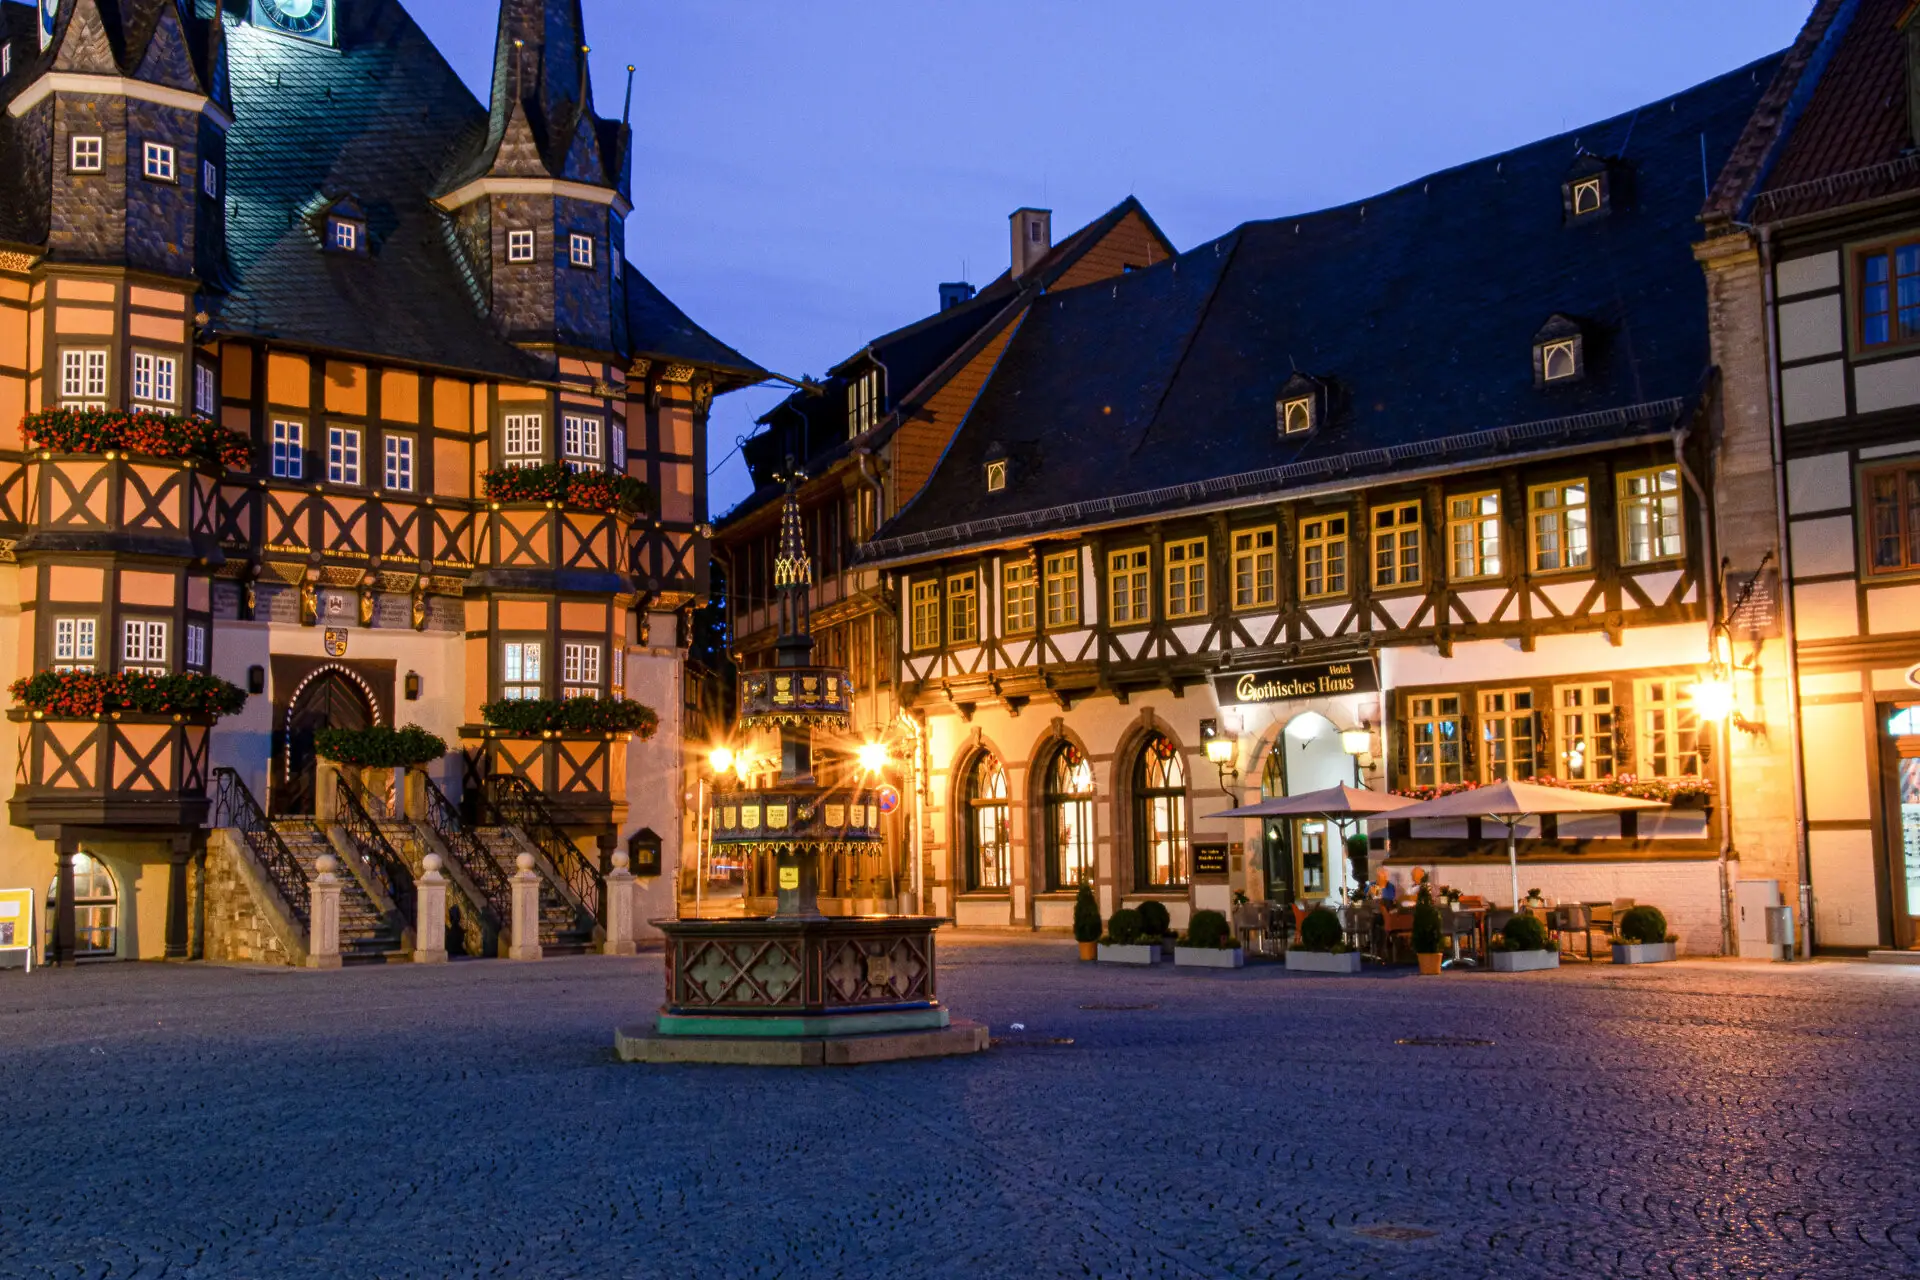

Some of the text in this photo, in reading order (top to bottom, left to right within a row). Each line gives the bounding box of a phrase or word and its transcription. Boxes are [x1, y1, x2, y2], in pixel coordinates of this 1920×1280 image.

[1329, 664, 1351, 675] Hotel
[1236, 673, 1355, 701] Gothisches Haus
